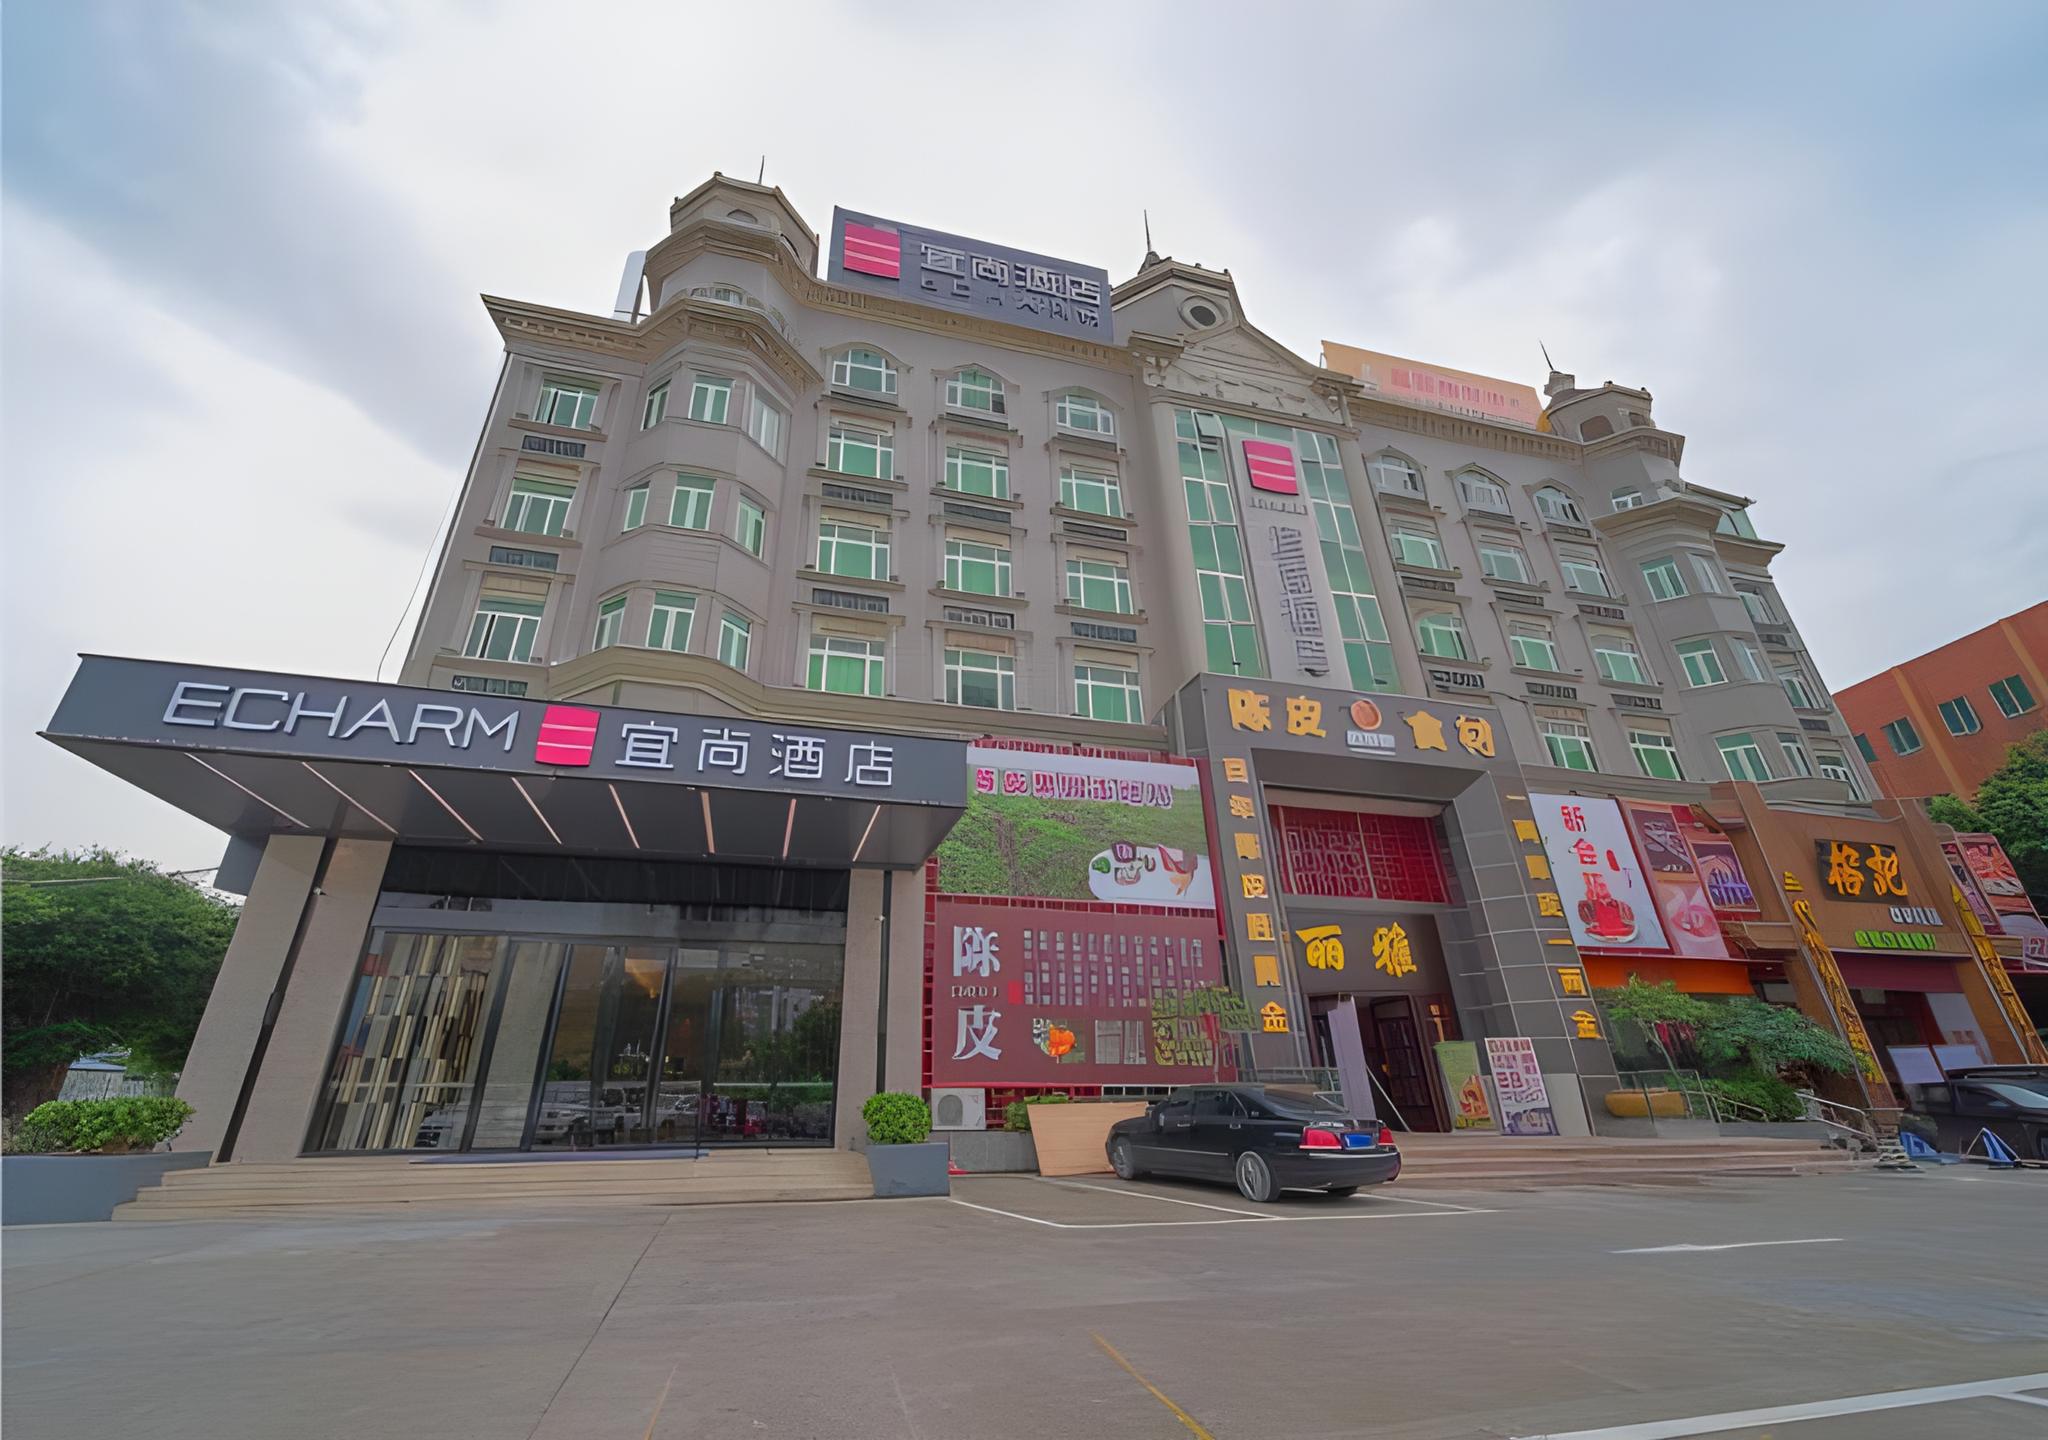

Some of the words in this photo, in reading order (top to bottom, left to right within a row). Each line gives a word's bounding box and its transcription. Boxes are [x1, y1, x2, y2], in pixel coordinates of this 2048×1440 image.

[162, 681, 520, 751] ECHARM
[614, 719, 893, 787] 宜尚酒店
